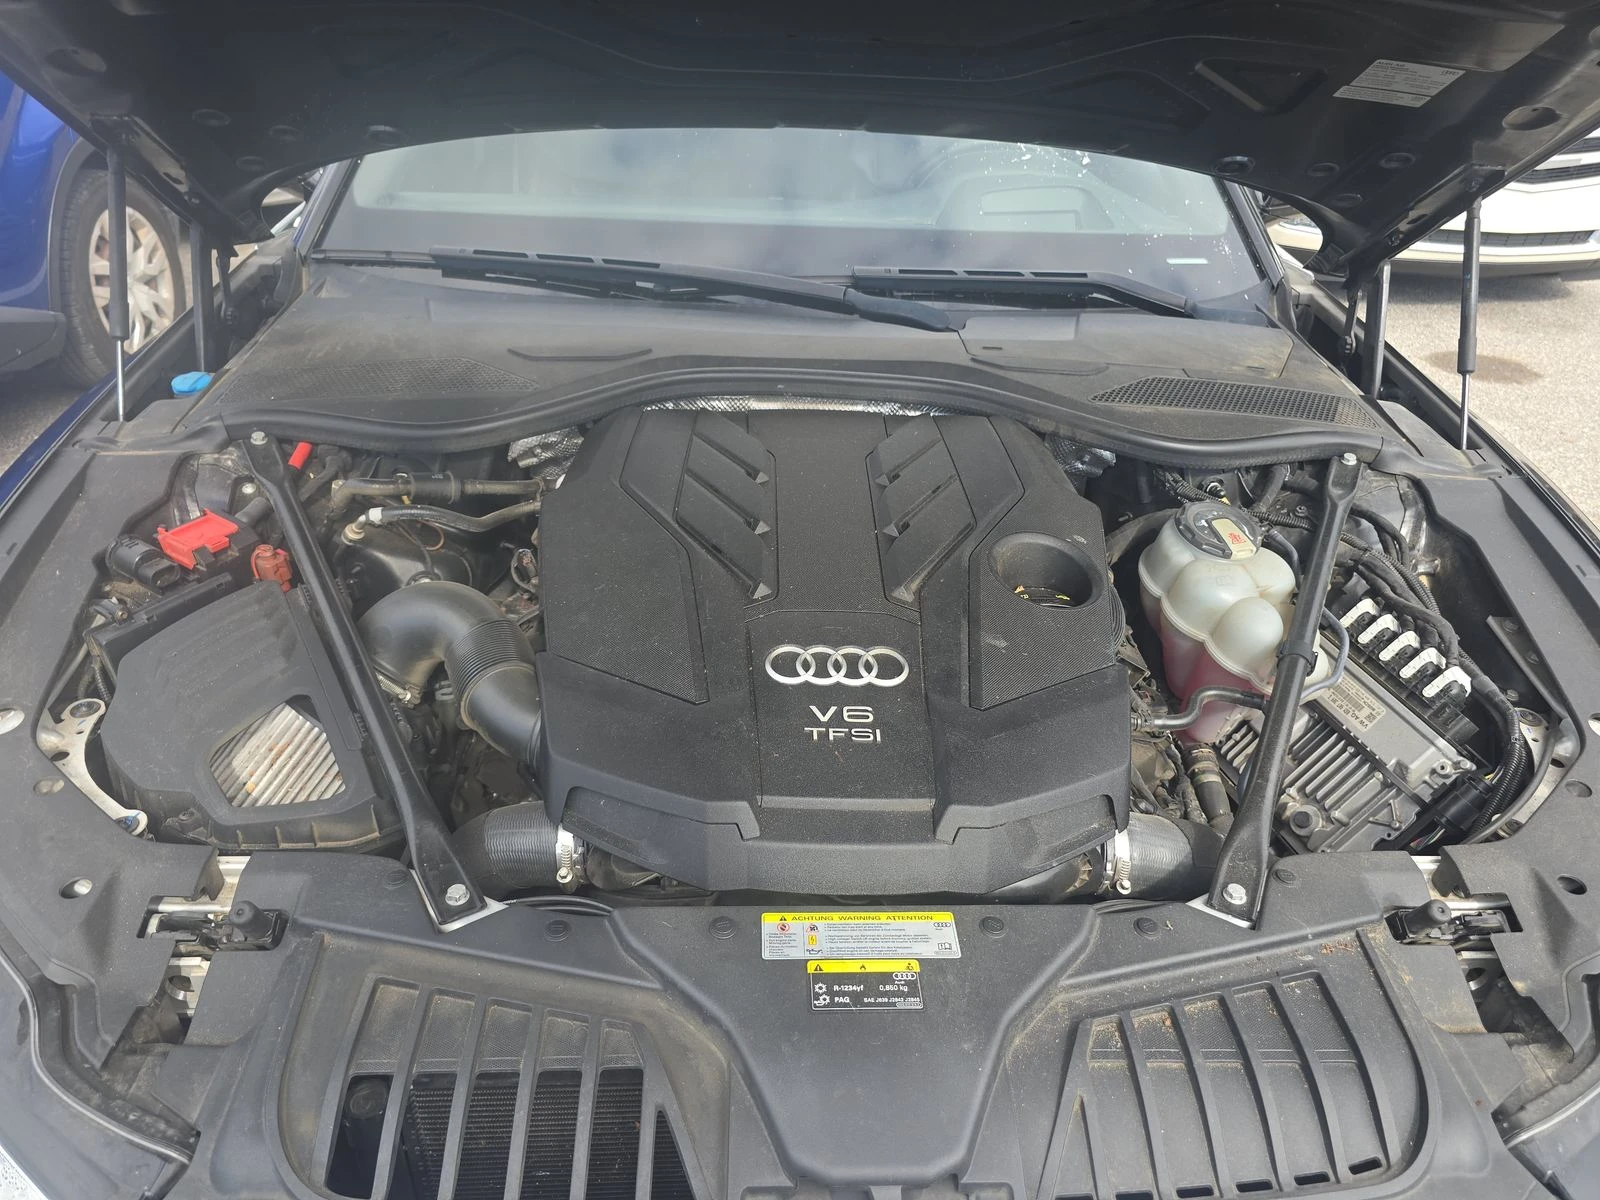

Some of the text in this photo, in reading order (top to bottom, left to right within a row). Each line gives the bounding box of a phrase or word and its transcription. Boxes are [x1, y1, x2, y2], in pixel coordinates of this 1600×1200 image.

[809, 705, 874, 723] V6
[804, 727, 882, 743] TFSI
[833, 984, 864, 992] R-1234yf
[899, 984, 908, 992] kg
